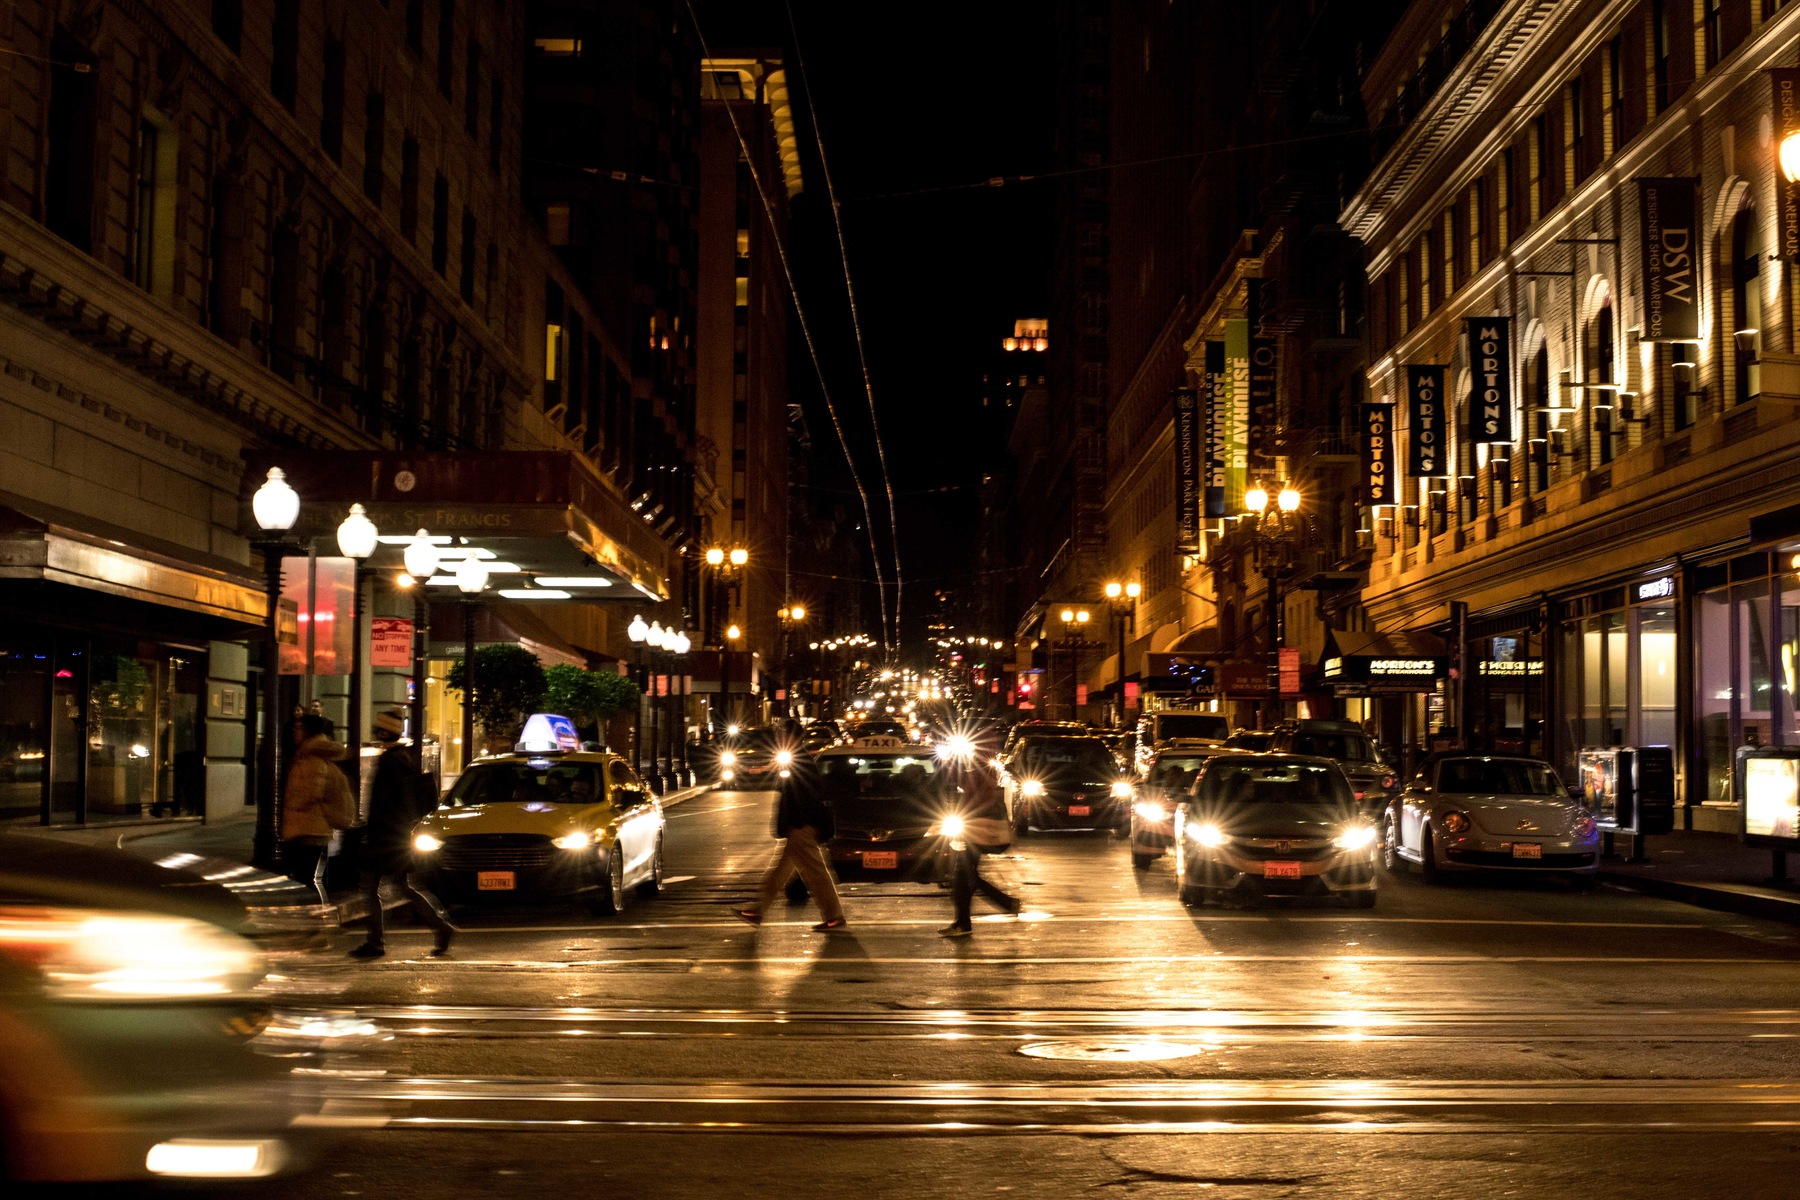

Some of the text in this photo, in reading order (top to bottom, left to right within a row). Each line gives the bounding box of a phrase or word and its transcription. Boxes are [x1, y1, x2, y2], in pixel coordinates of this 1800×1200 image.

[1646, 188, 1659, 242] DESIGNER
[1648, 243, 1661, 273] SHOE
[1661, 227, 1692, 305] DSW
[1225, 357, 1233, 468] SAN FRANCISCO
[1479, 325, 1500, 435] MORTONS
[1204, 372, 1213, 487] SAN FRANCISCO
[1368, 411, 1386, 499] MORTONS
[1417, 375, 1436, 472] MORTONS
[1181, 411, 1194, 541] KENSINGTON PARK HOTEL
[435, 509, 511, 527] FRANCIS
[372, 632, 384, 640] NO
[374, 644, 406, 653] ANY TIME
[1370, 660, 1435, 669] MORTON'S
[862, 739, 895, 747] TAXI
